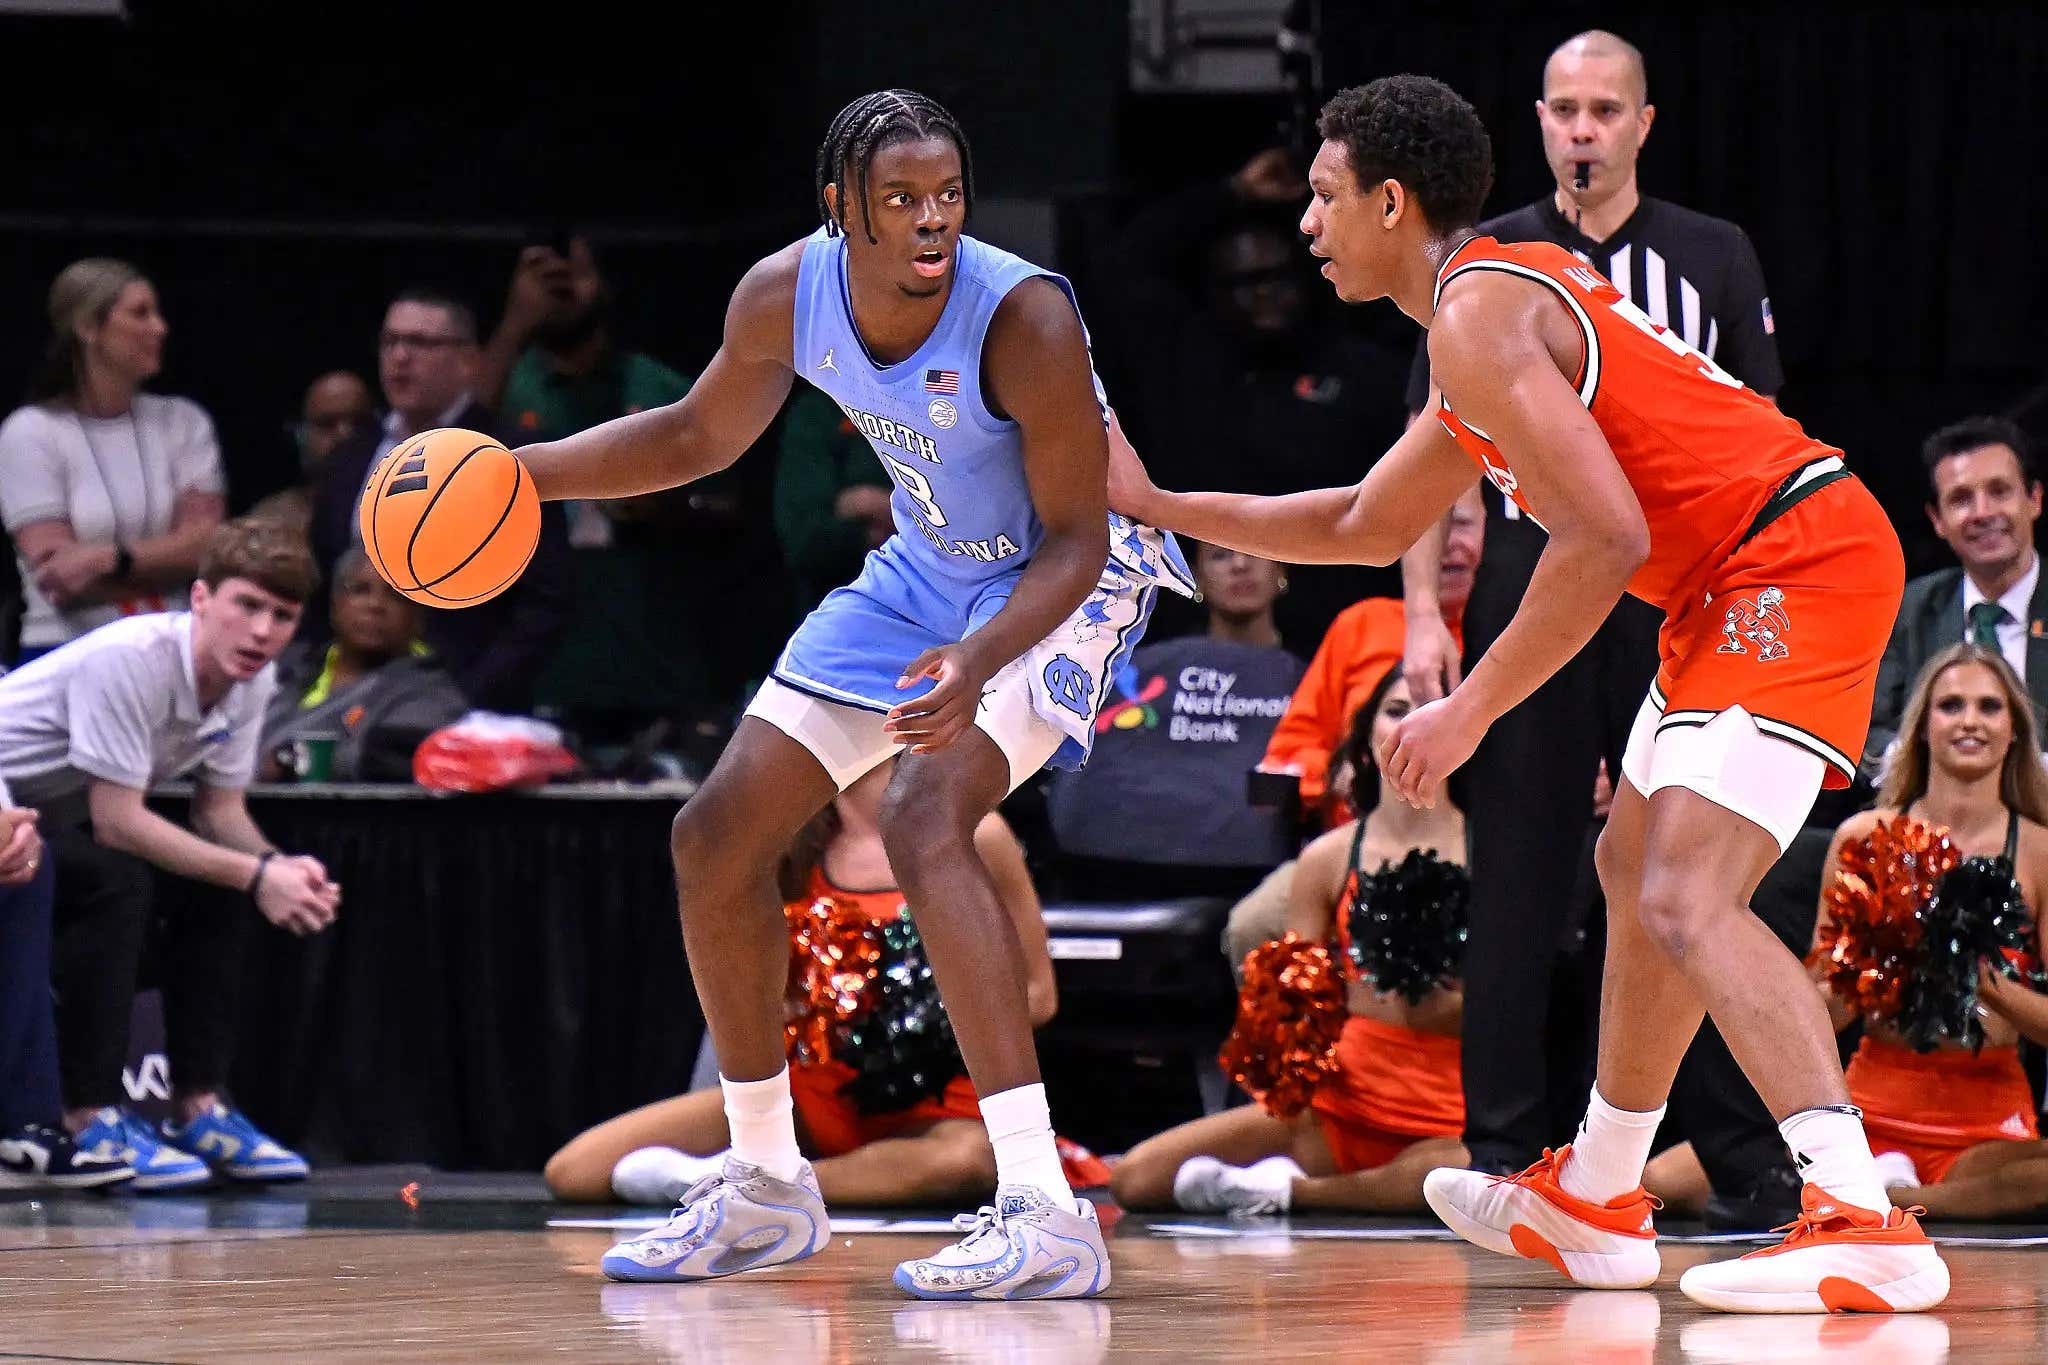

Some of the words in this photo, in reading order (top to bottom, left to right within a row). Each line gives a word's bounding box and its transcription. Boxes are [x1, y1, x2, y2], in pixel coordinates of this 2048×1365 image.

[844, 404, 943, 465] NORTH
[1180, 666, 1237, 698] City
[1169, 716, 1240, 742] Bank
